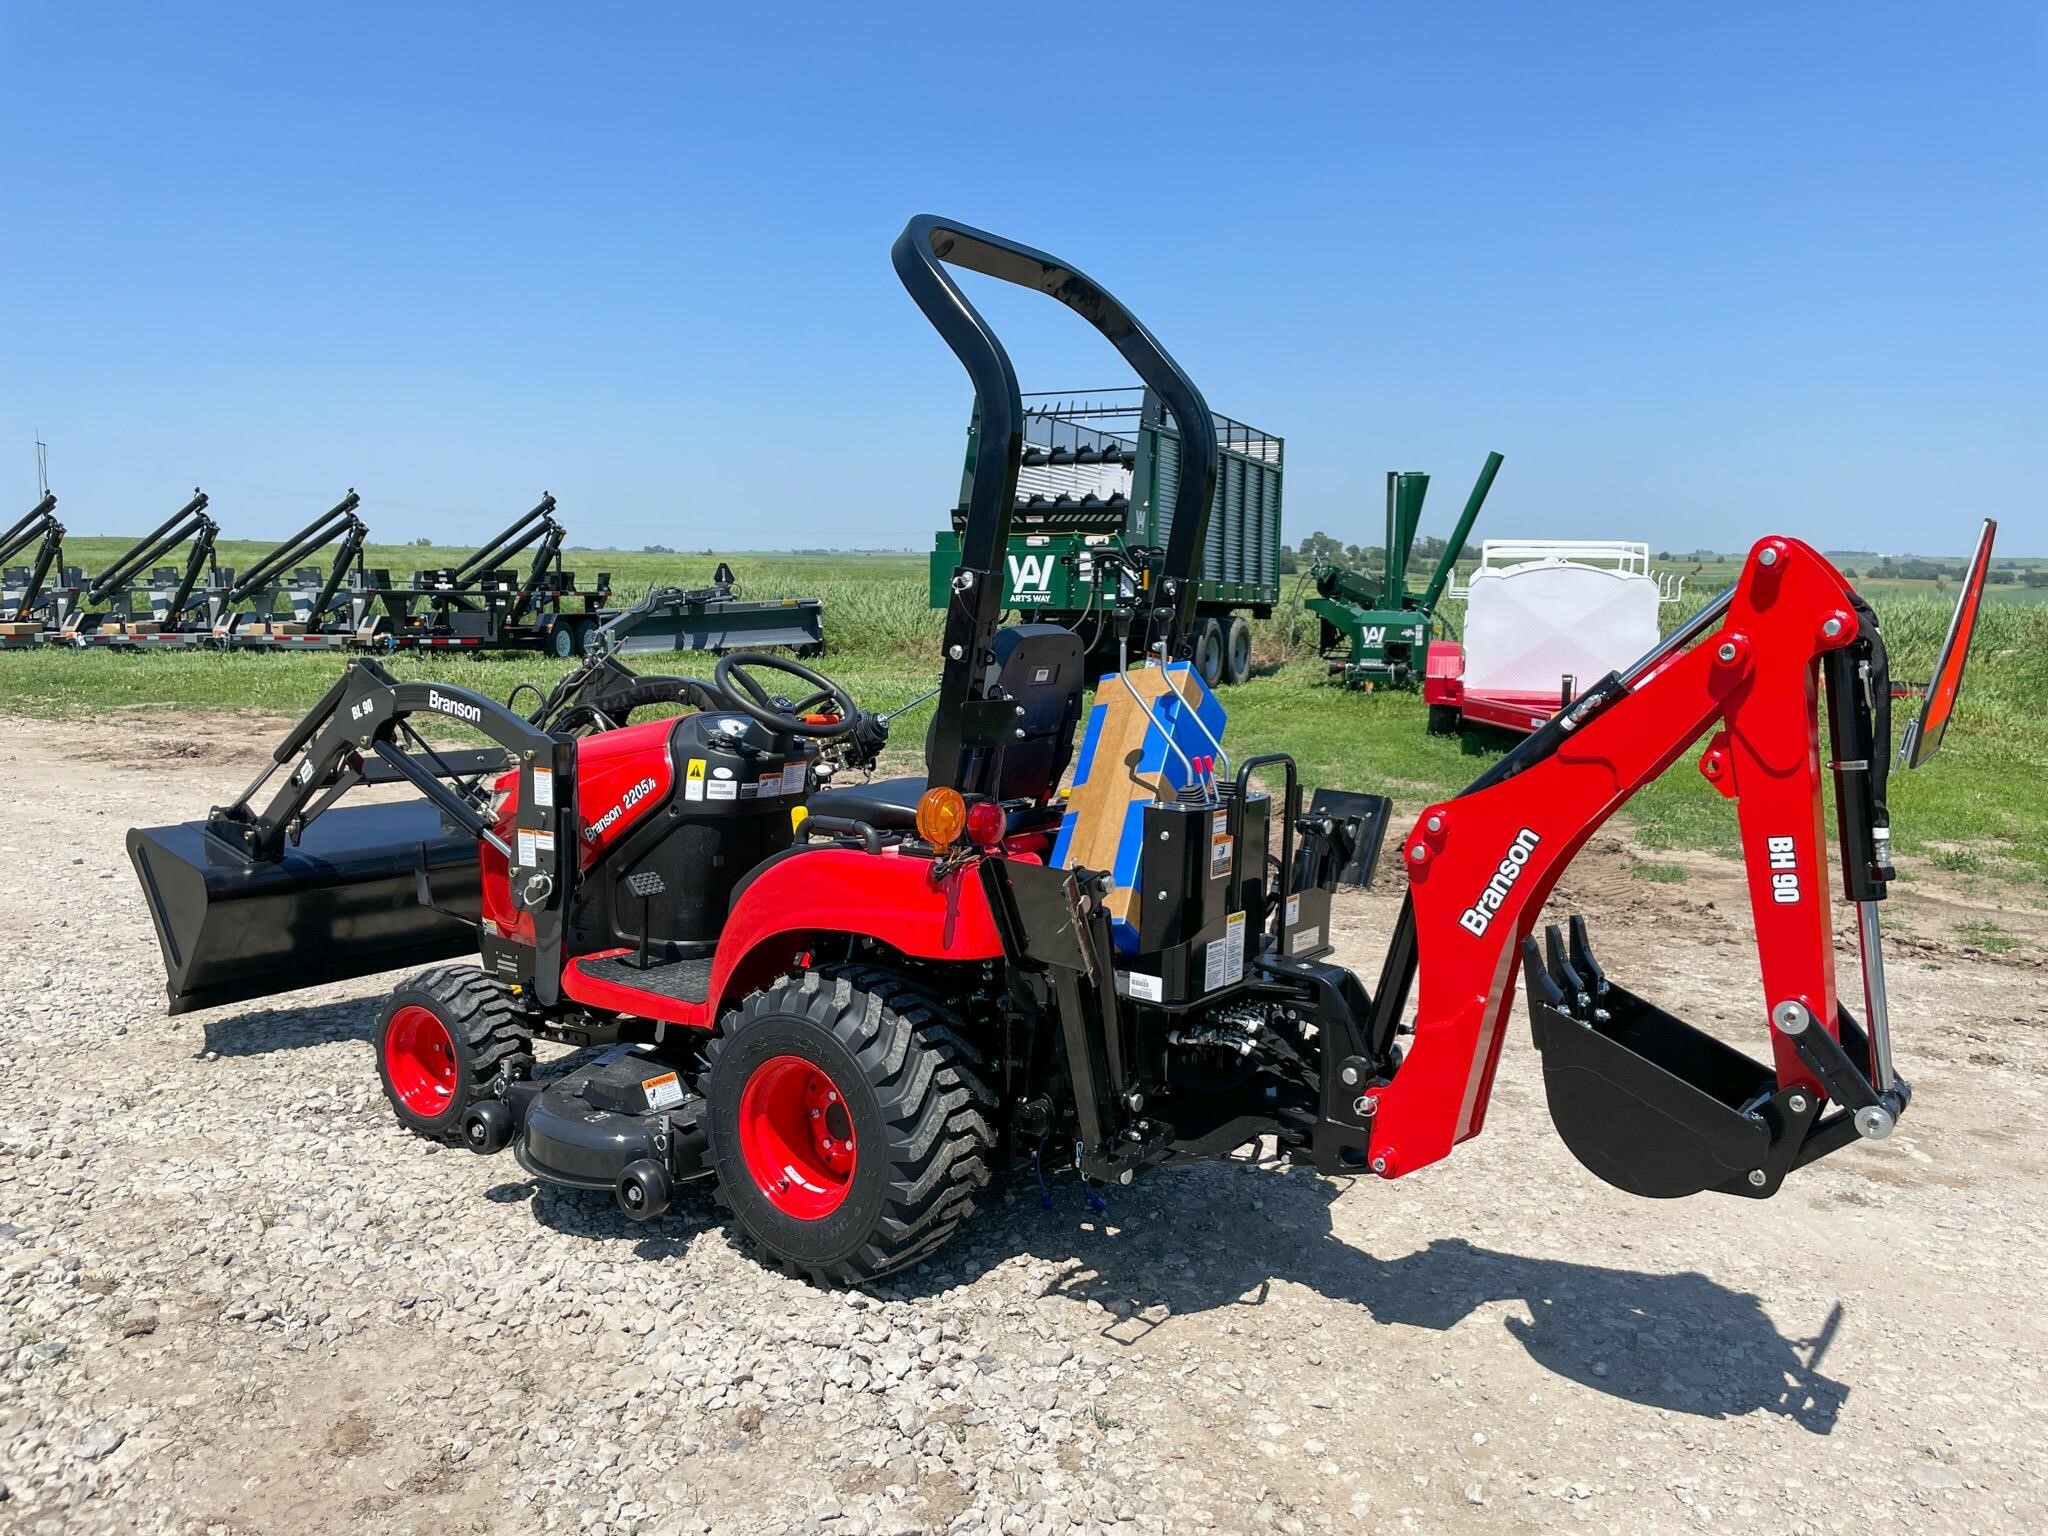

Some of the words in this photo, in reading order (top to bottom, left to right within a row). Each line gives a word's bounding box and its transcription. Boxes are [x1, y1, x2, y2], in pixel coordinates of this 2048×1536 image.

[1009, 594, 1032, 602] ART'S
[1032, 594, 1051, 602] WAY
[351, 705, 363, 720] BL
[362, 698, 374, 714] 90
[429, 689, 481, 722] Branson
[584, 804, 623, 843] Branson
[1767, 836, 1797, 869] BH
[1459, 828, 1541, 938] Branson
[1771, 873, 1800, 903] 90
